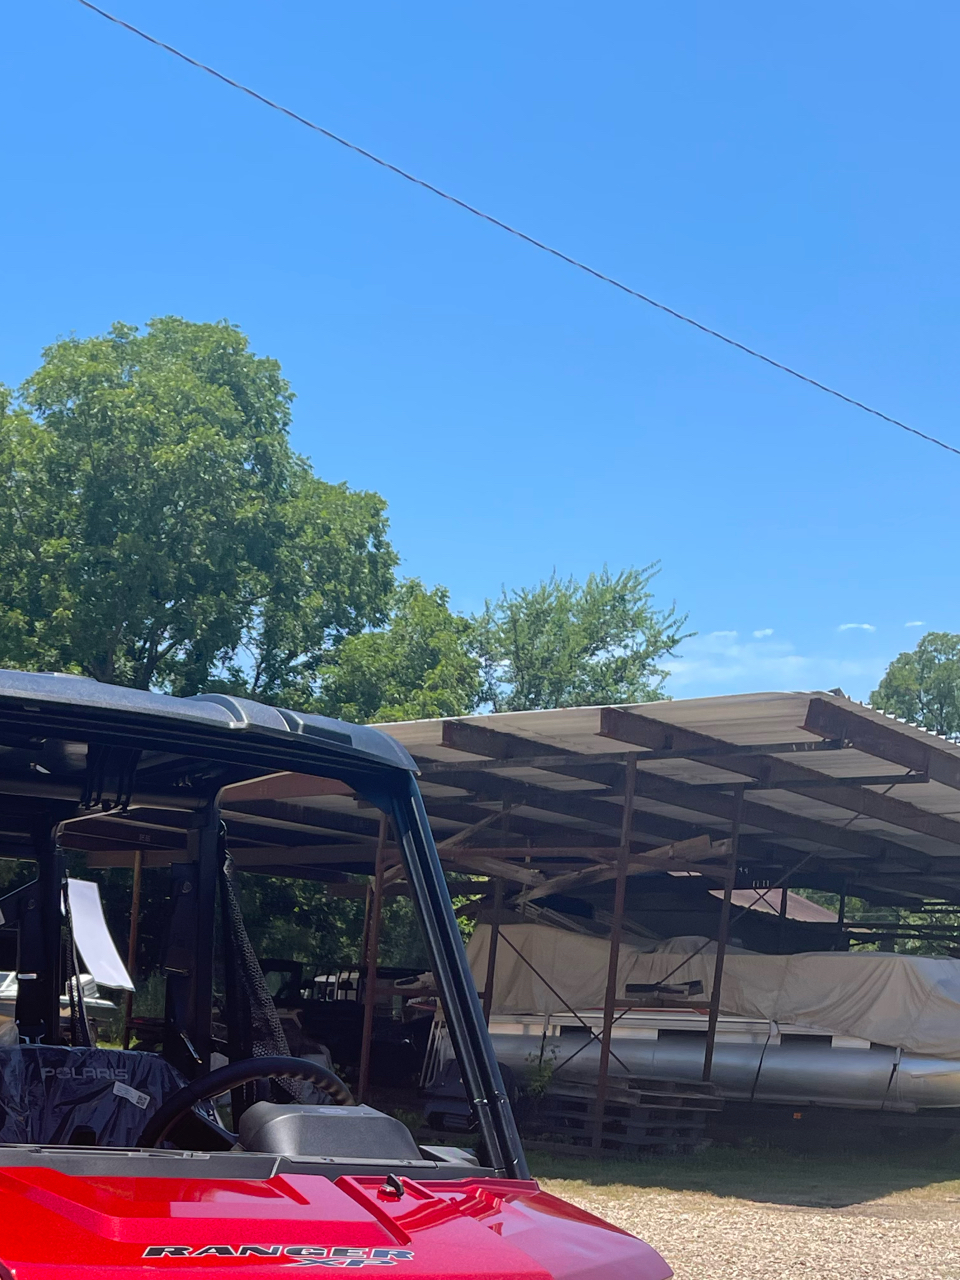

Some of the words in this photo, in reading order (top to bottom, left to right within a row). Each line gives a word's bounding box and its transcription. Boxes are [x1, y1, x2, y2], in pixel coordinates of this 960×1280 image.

[41, 1067, 129, 1080] POLARIS
[141, 1246, 415, 1260] RANGER
[280, 1258, 397, 1267] XP
